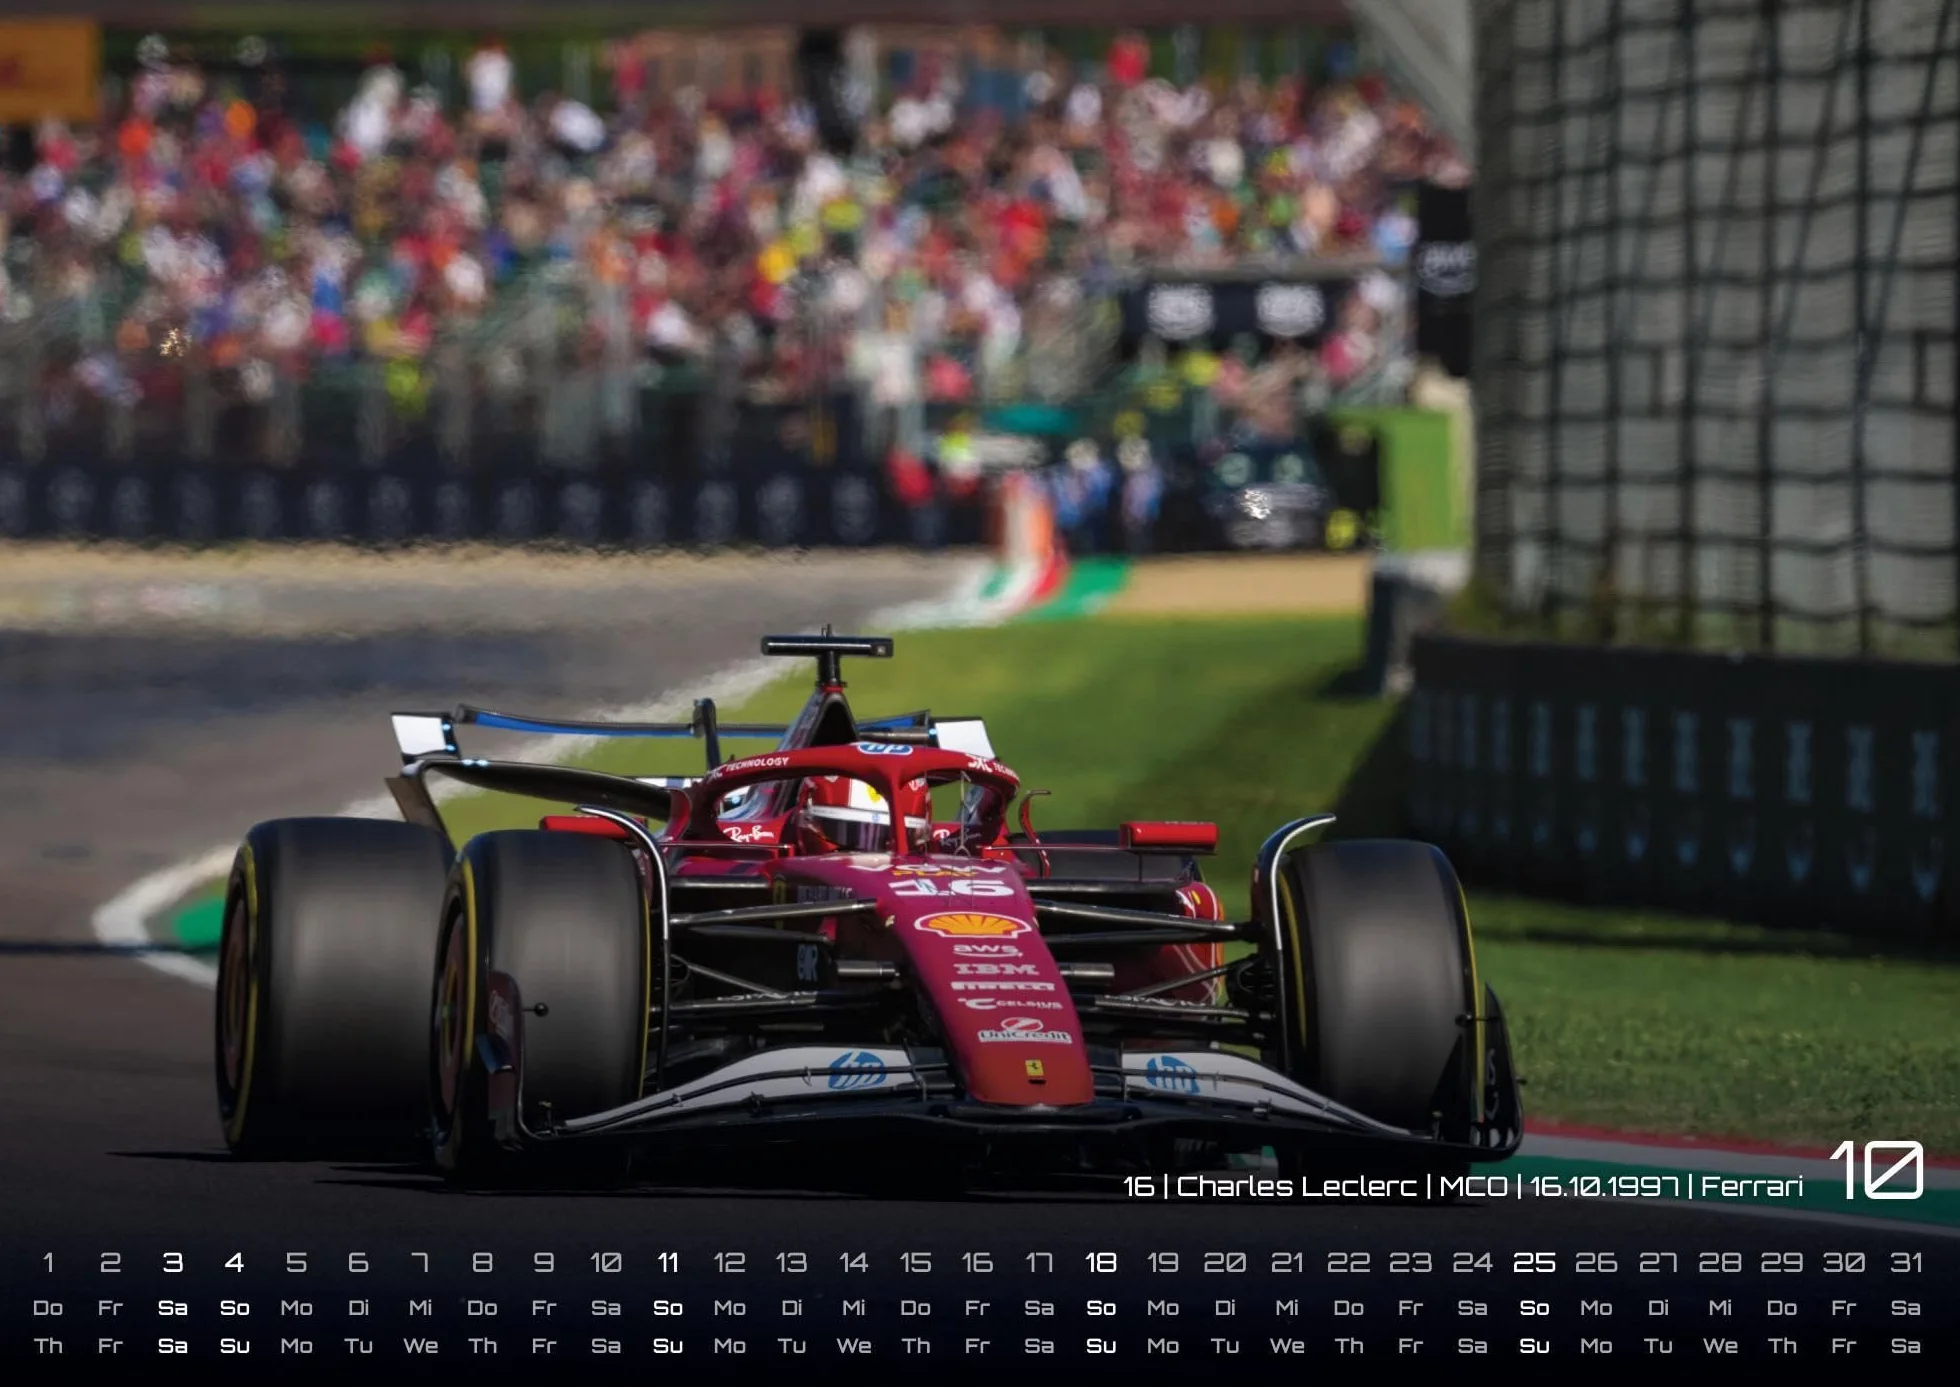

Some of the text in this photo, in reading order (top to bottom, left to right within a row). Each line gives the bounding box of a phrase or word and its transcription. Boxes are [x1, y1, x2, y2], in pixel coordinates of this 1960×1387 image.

[725, 757, 789, 772] TECHNOLOGY
[888, 879, 1015, 896] 16
[953, 944, 1020, 954] aws
[953, 963, 1040, 975] IBM
[979, 1030, 1070, 1041] UniCredit
[829, 1050, 885, 1091] hp
